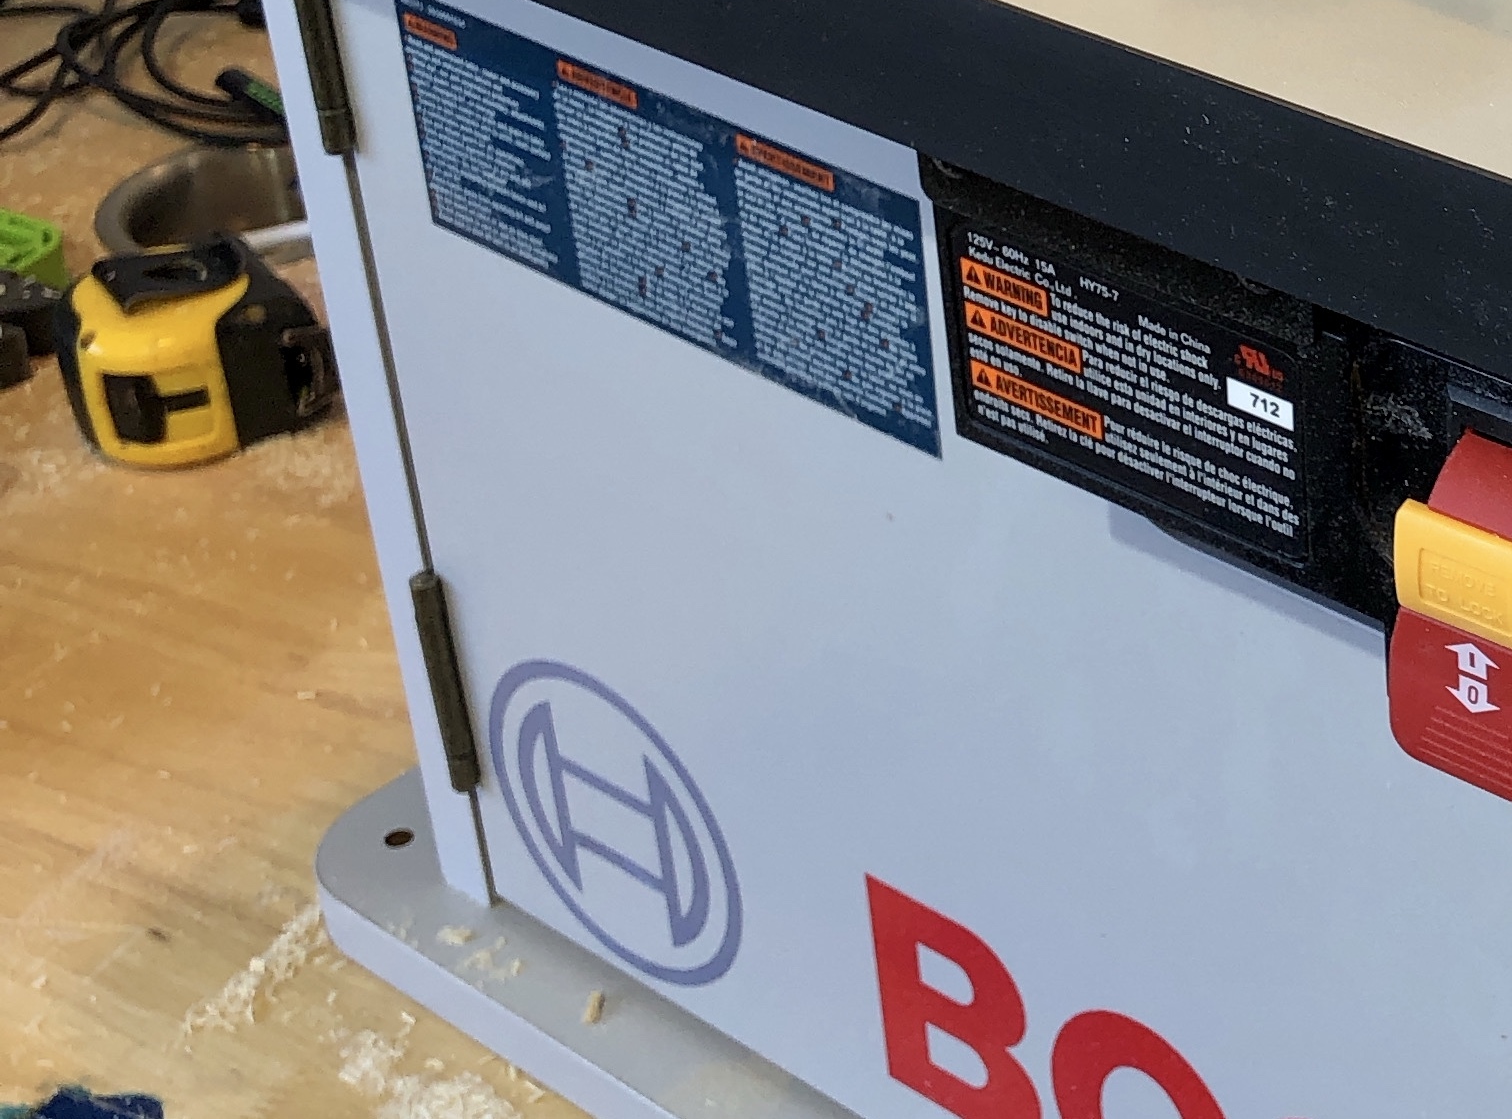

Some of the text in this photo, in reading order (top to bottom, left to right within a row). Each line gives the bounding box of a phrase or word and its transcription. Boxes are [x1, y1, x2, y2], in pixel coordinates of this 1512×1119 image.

[995, 256, 1031, 280] Electric
[1001, 244, 1029, 265] 60Hz
[1035, 258, 1055, 275] 15A
[1079, 276, 1119, 302] HY75-7
[982, 270, 1208, 369] WARNING To reduce the risk of electric shock
[1000, 302, 1017, 320] key
[1018, 309, 1027, 322] to
[1094, 340, 1119, 361] when
[1121, 352, 1136, 368] not
[1138, 358, 1147, 372] in
[1149, 366, 1169, 382] use.
[1138, 314, 1211, 354] Made in China
[989, 315, 1297, 452] ADVERTENCIA Para reducir el riesgo de descargas eléctricas.
[1105, 331, 1122, 348] and
[1124, 337, 1134, 353] in
[1135, 343, 1151, 362] dry
[1152, 350, 1195, 379] locations
[1197, 368, 1221, 391] only.
[994, 373, 1098, 433] AVERTISSEMENT
[1103, 415, 1125, 435] Pour
[1161, 440, 1171, 455] le
[1172, 445, 1202, 470] risque
[1203, 459, 1215, 474] de
[1217, 465, 1240, 485] choc
[1075, 375, 1084, 389] la
[1110, 392, 1131, 411] para
[1133, 400, 1181, 431] desactivar
[1182, 421, 1192, 436] el
[1194, 426, 1244, 460] interruptor
[1245, 448, 1280, 473] cuando
[1282, 466, 1295, 480] no
[1113, 378, 1133, 396] esta
[1168, 403, 1180, 416] en
[1182, 406, 1227, 436] interiores
[1229, 430, 1235, 442] y
[1237, 433, 1249, 446] en
[1251, 436, 1288, 464] lugares
[1249, 393, 1279, 417] 712
[1095, 442, 1116, 461] pour
[1138, 445, 1187, 475] seulement
[1244, 492, 1254, 506] et
[1256, 496, 1279, 517] dans
[1281, 508, 1299, 525] des
[1426, 584, 1503, 624] TO LOCK
[1431, 562, 1497, 596] REMOVE
